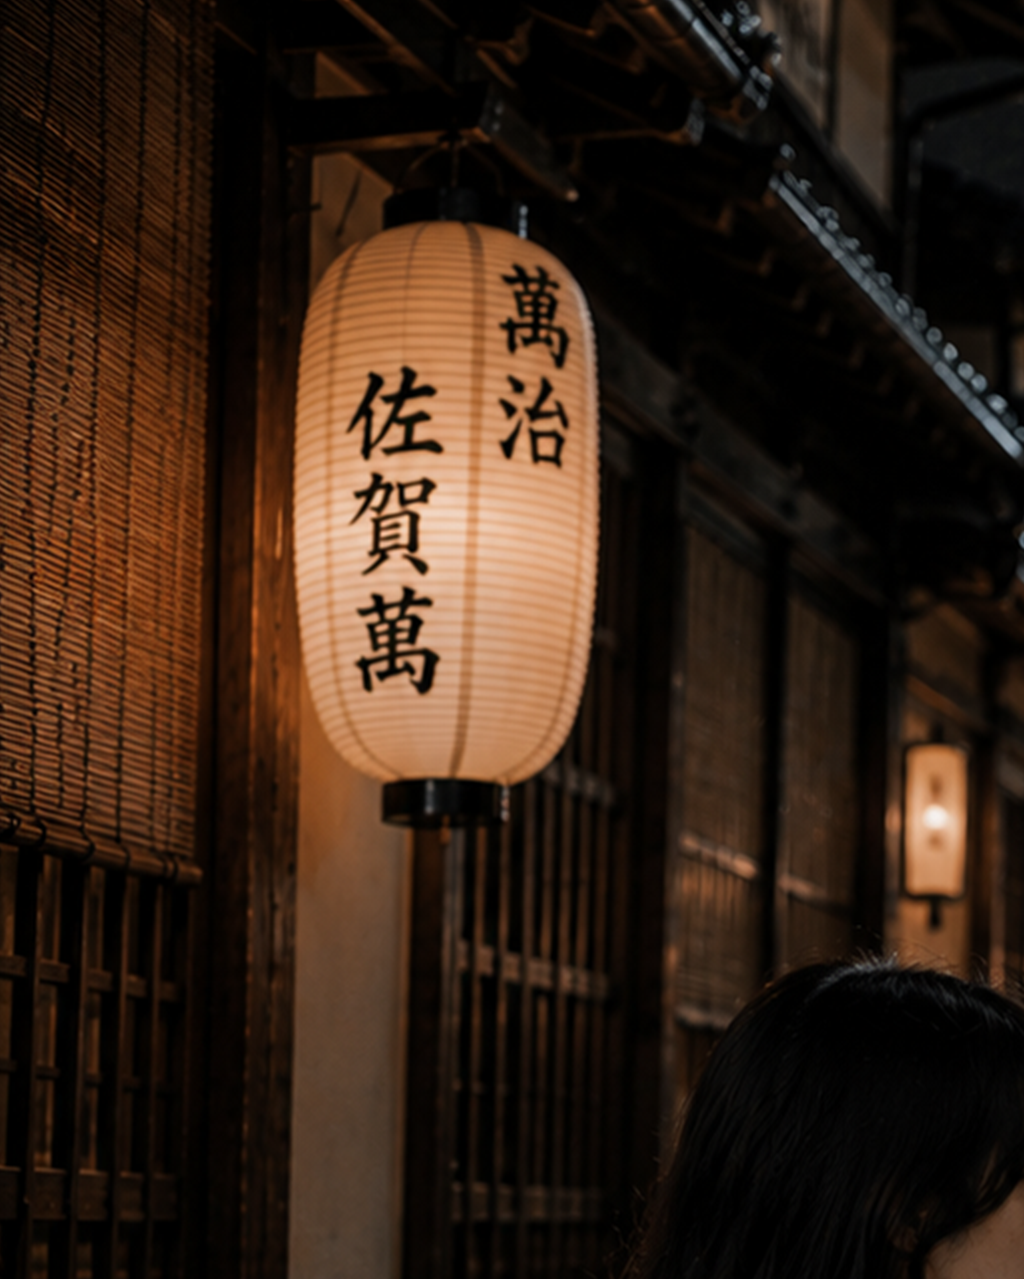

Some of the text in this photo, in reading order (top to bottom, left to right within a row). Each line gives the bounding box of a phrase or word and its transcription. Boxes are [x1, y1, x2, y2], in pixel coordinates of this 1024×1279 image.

[498, 262, 570, 468] 萬治
[345, 365, 444, 695] 佐賀萬
